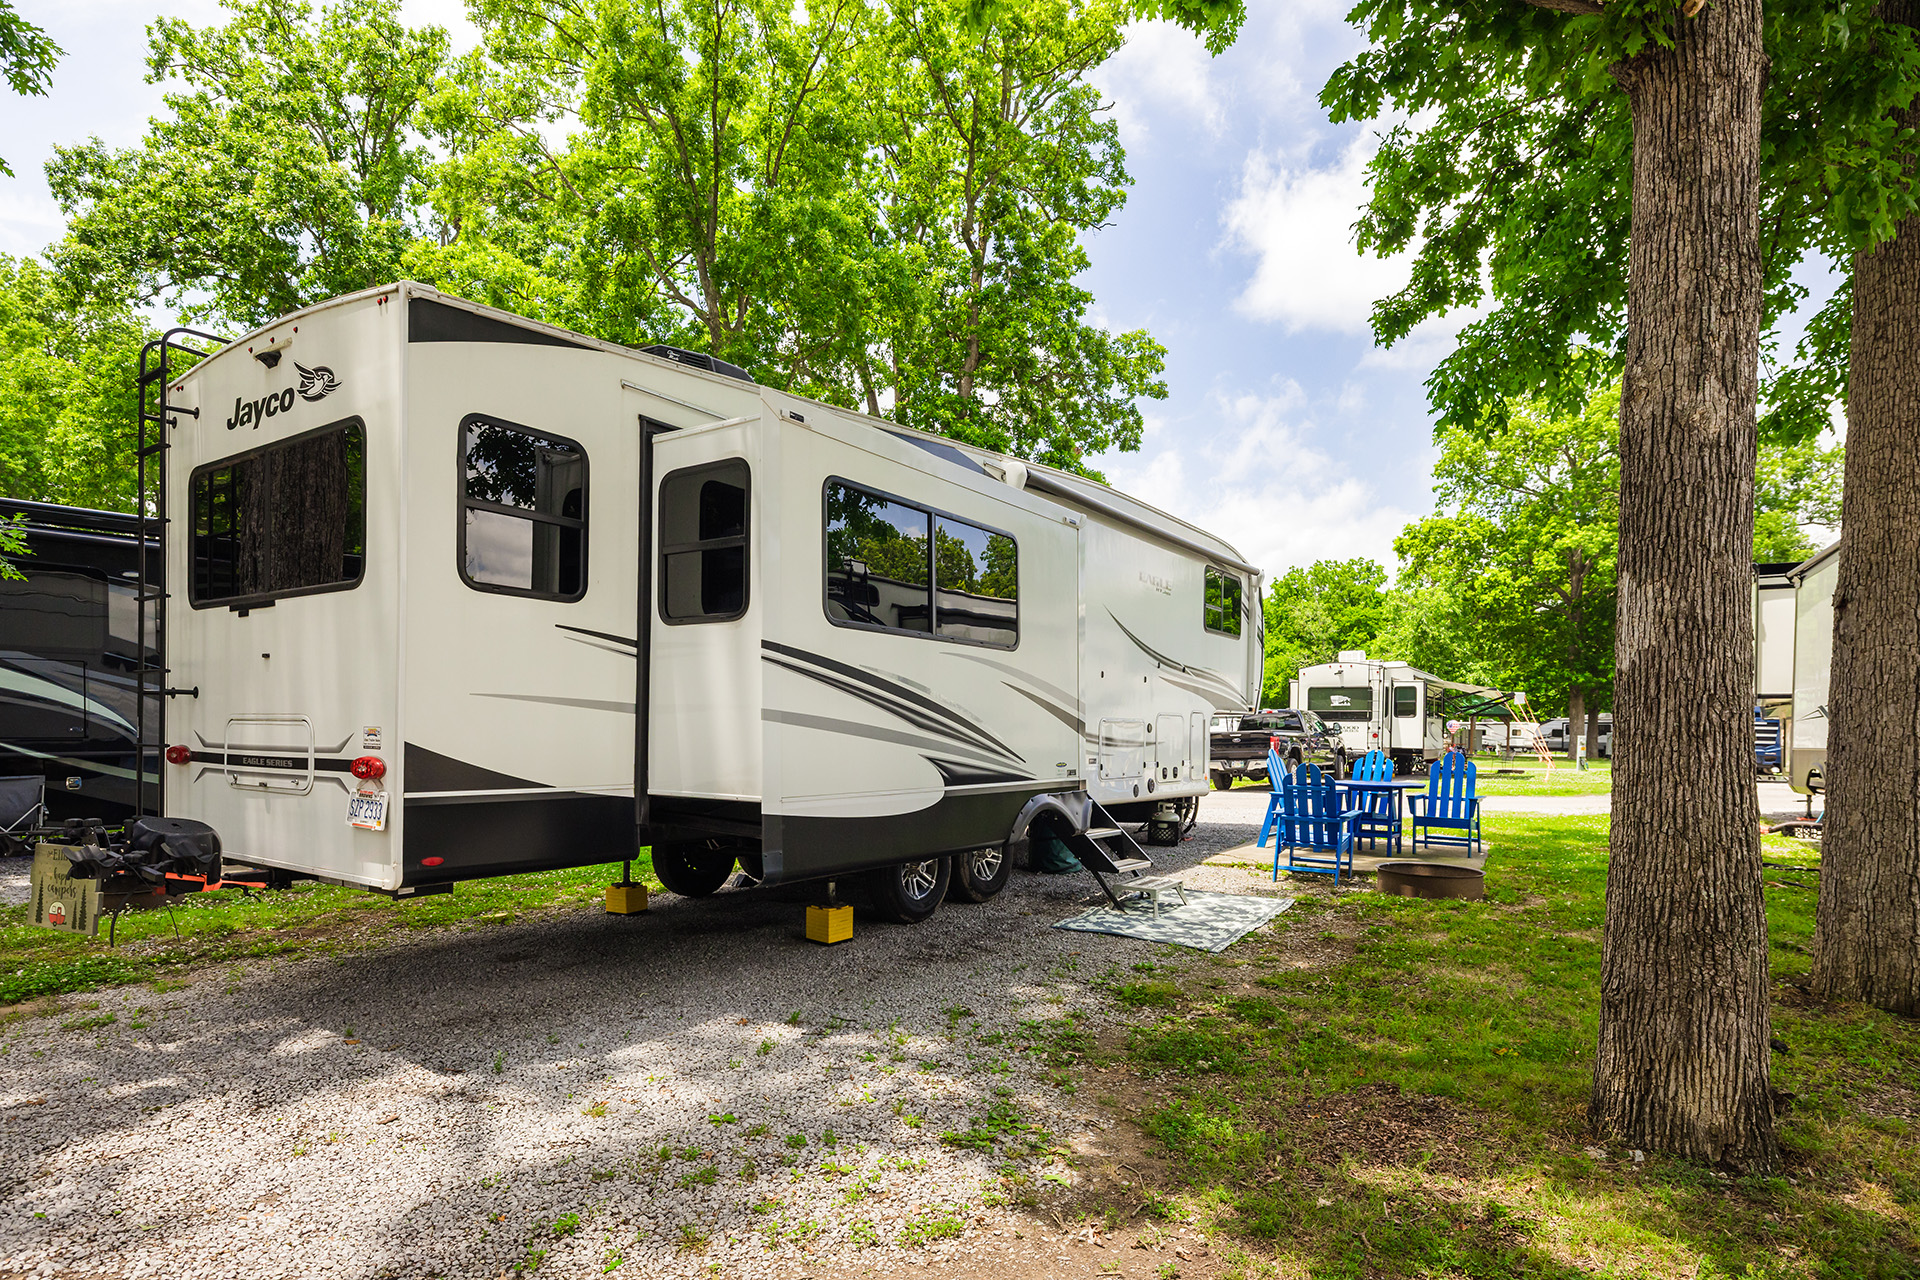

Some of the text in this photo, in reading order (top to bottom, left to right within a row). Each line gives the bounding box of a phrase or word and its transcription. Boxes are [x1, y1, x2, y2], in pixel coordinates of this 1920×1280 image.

[226, 387, 295, 430] Jayco
[242, 757, 293, 767] EAGLE SERIES
[349, 798, 364, 818] SZP
